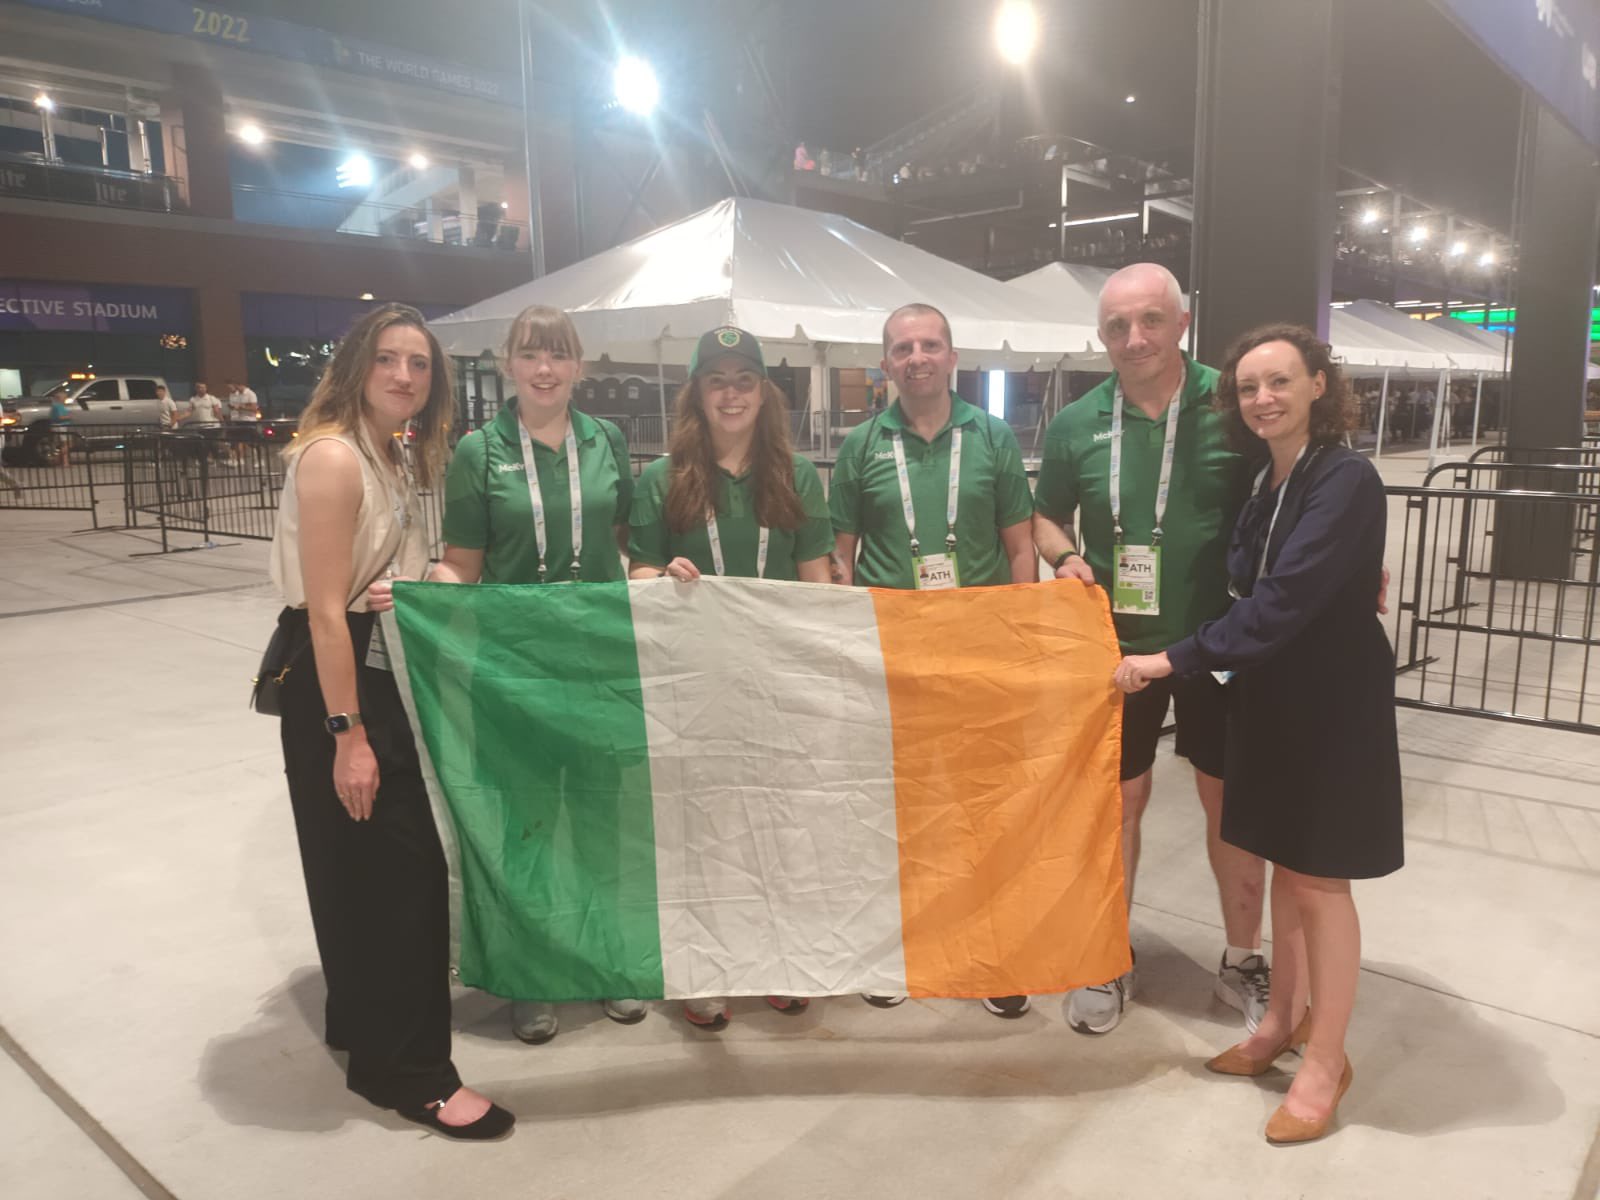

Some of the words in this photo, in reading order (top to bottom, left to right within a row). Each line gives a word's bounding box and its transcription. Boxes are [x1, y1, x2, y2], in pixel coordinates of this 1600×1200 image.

[193, 8, 250, 42] 2022
[359, 53, 383, 71] THE
[385, 57, 430, 79] WORLD
[73, 301, 158, 320] STADIUM
[930, 570, 950, 581] ATH
[1129, 563, 1152, 573] ATH
